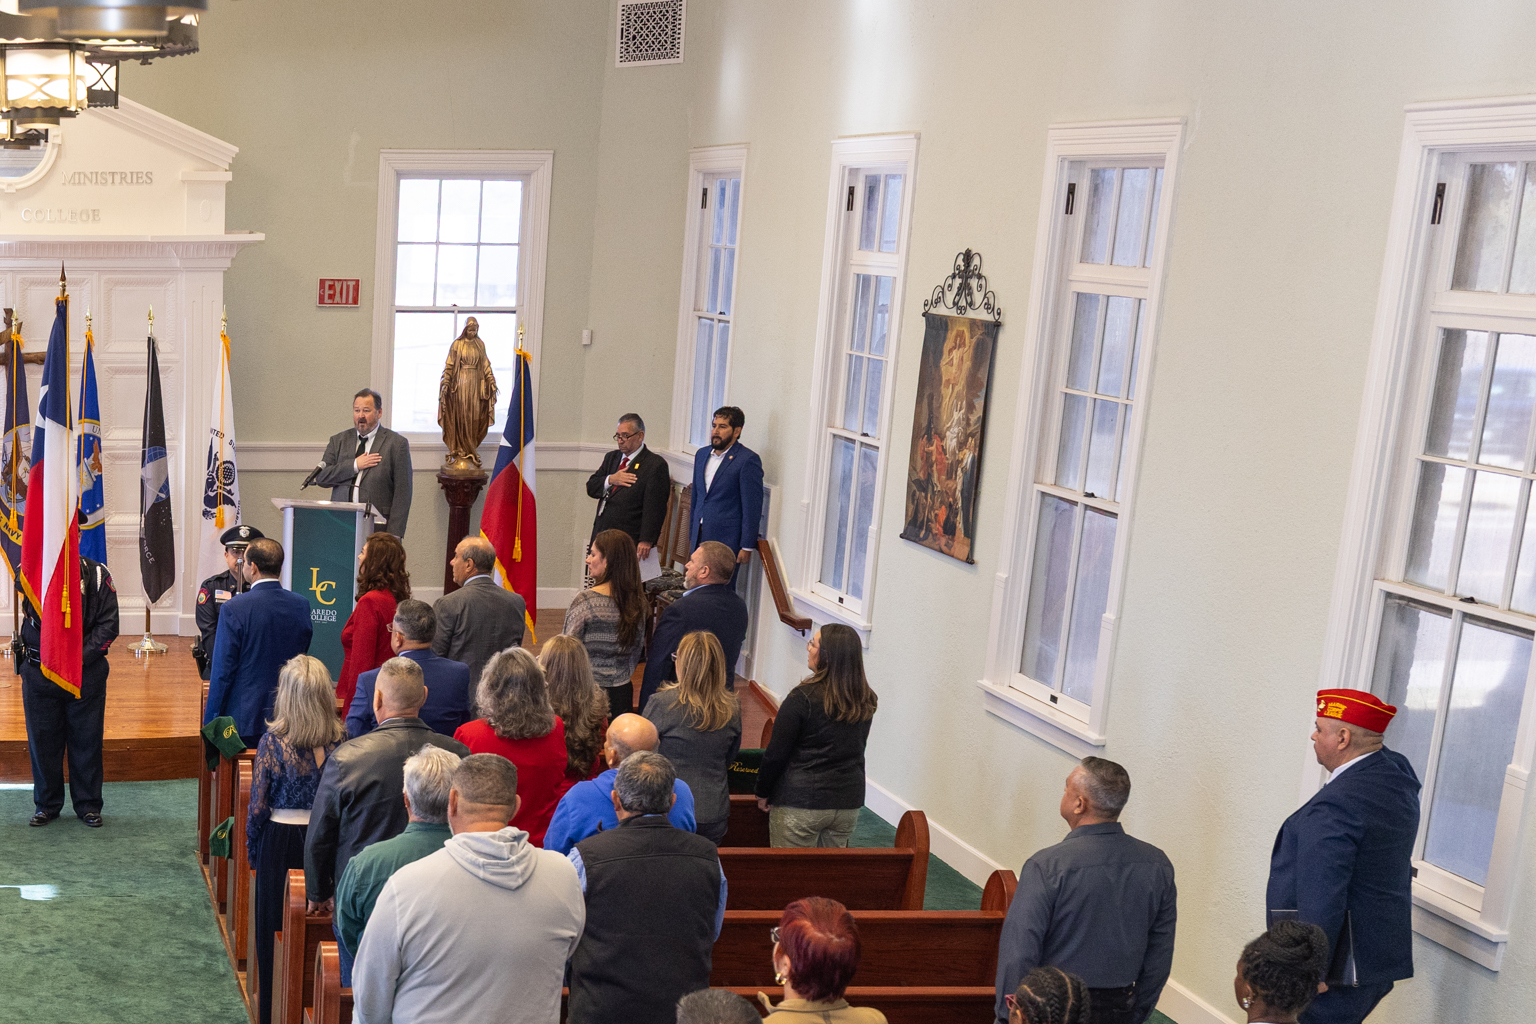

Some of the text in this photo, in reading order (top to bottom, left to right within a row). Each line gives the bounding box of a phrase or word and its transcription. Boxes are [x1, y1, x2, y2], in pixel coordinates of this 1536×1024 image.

[61, 171, 153, 186] MINISTRIES
[21, 208, 101, 223] COLLEGE
[324, 280, 356, 304] EXIT
[3, 522, 22, 540] NVY
[310, 608, 337, 617] AREDO
[310, 614, 337, 623] OLLEGE
